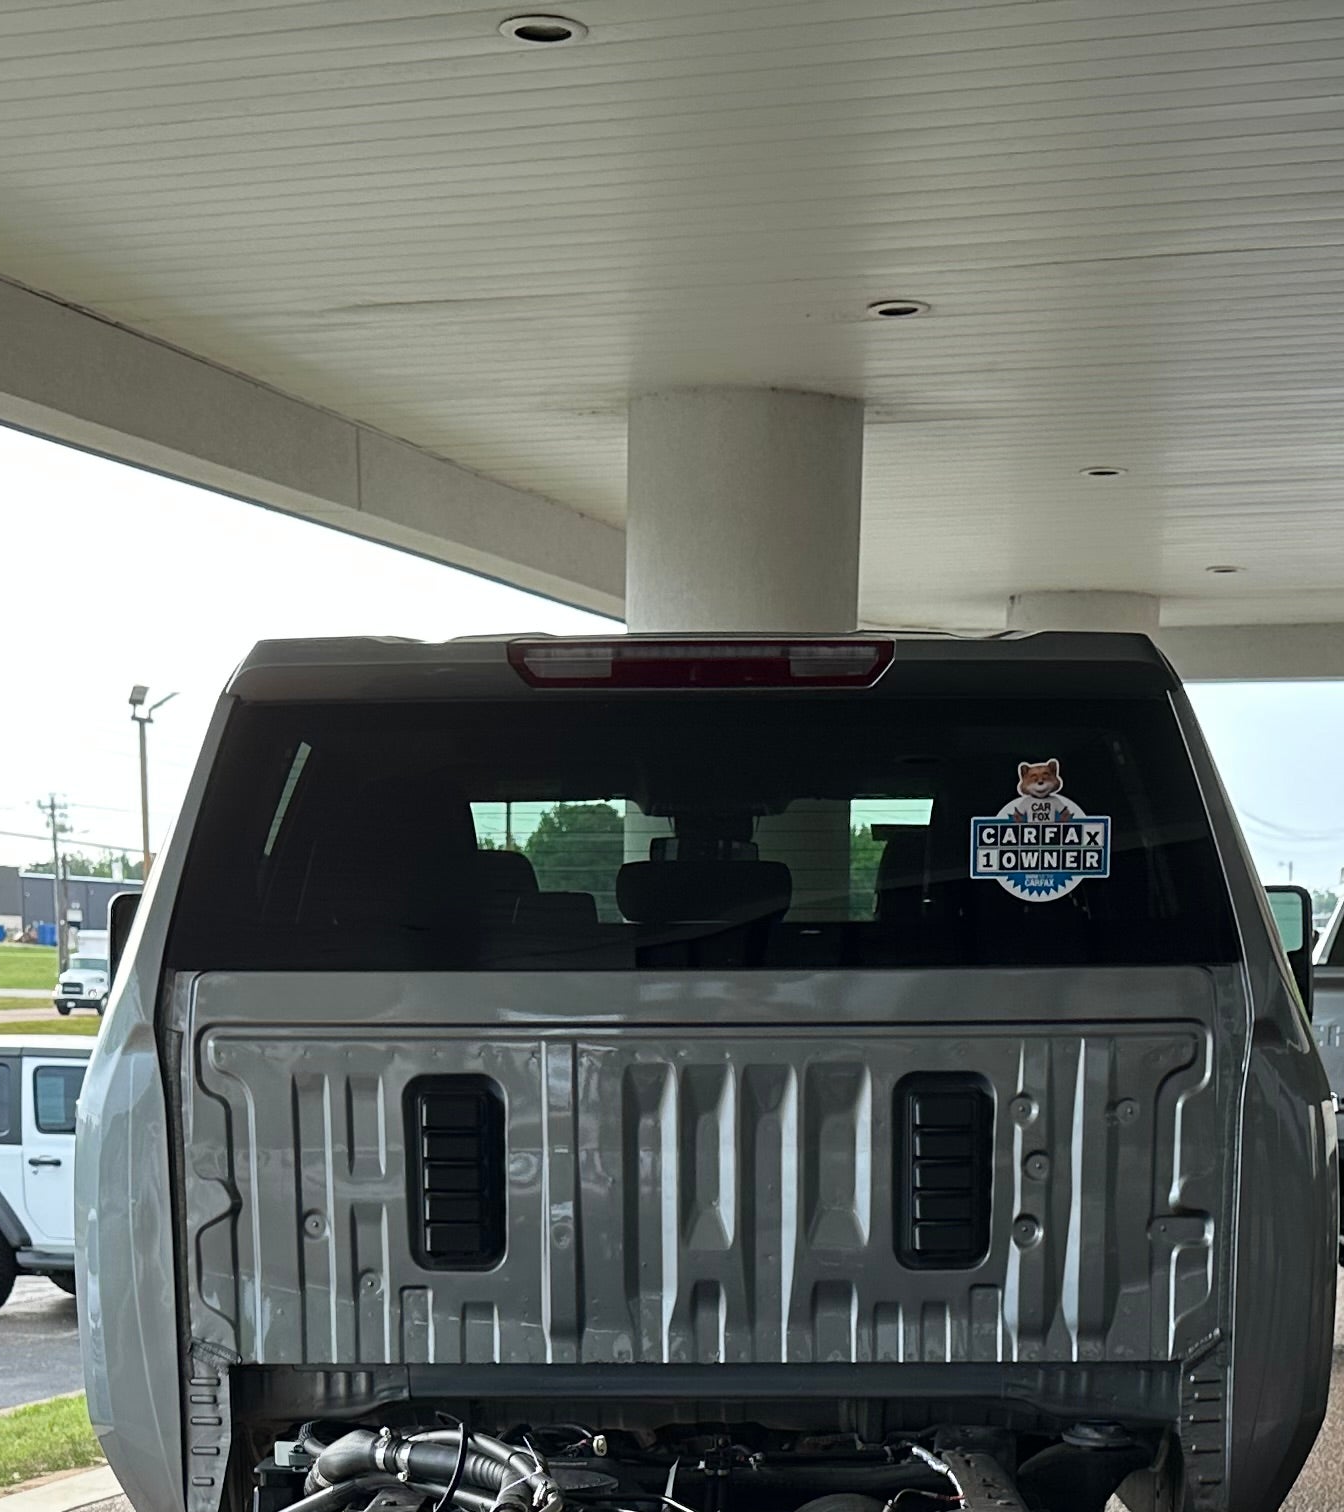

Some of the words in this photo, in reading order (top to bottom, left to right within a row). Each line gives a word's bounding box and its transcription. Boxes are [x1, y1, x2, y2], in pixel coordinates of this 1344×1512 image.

[1031, 802, 1052, 813] CAR
[1032, 812, 1051, 822] FOX
[981, 827, 1100, 846] CARFAX
